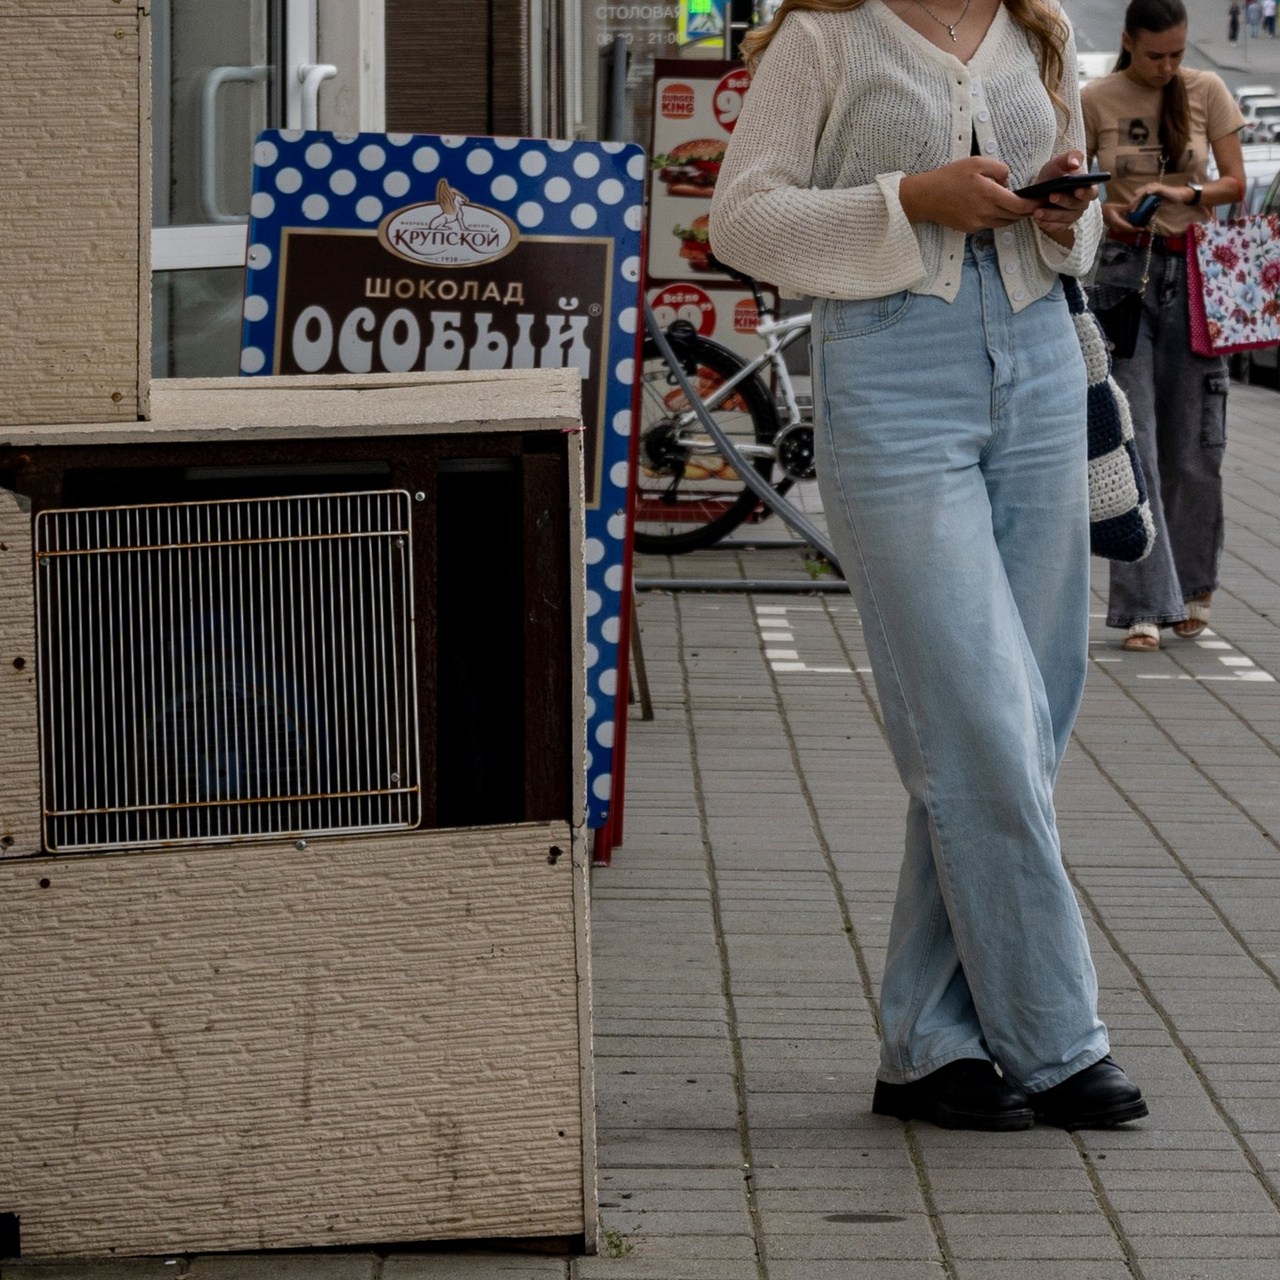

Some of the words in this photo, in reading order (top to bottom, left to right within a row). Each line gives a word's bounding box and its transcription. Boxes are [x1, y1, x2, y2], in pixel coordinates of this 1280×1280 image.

[596, 5, 683, 20] СТОЛОВАЯ
[662, 94, 695, 103] BURGER
[662, 102, 694, 113] KING
[393, 228, 503, 255] КРУПСКОЙ
[365, 276, 525, 306] ШОКОЛАД
[734, 317, 762, 328] KIN
[291, 296, 591, 380] ОСОБЫЙ
